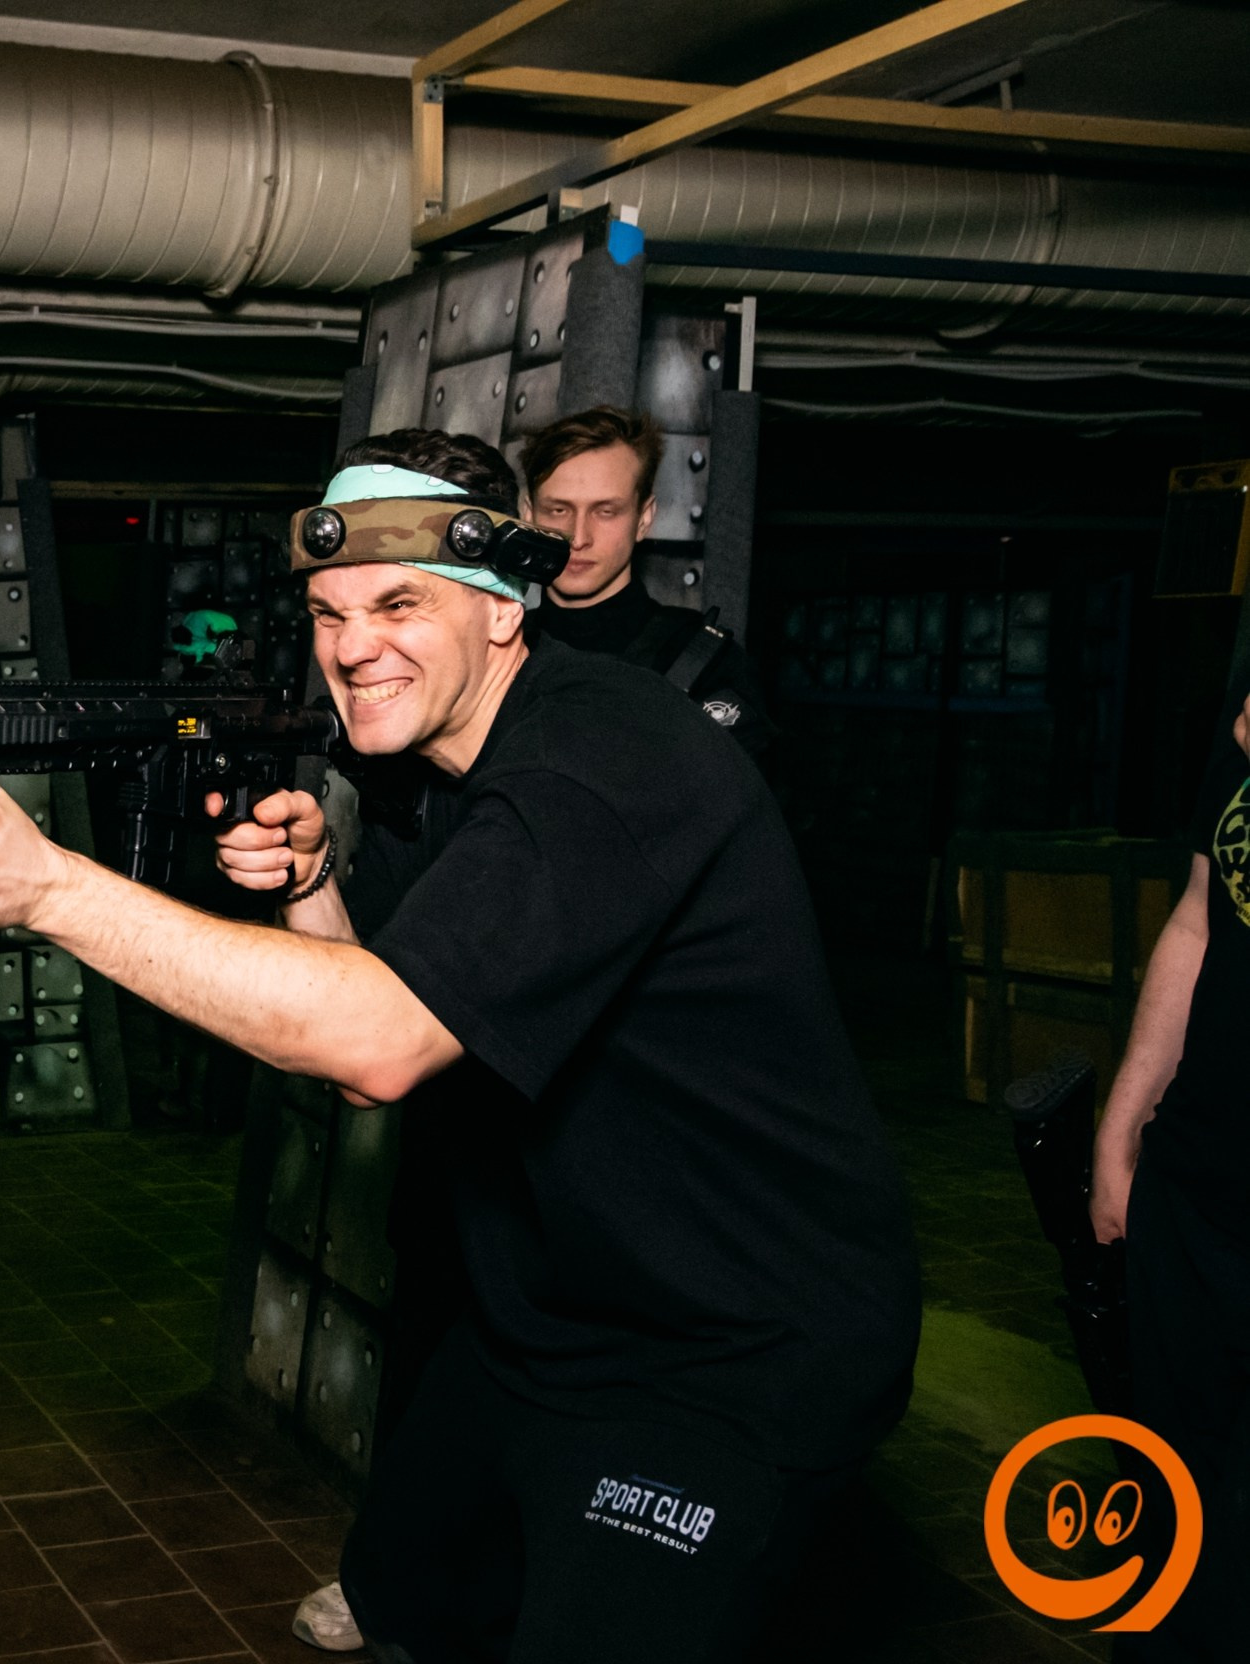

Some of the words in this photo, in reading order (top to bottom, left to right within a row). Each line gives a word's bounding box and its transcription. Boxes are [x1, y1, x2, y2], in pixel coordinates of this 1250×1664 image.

[584, 1511, 601, 1521] GET
[602, 1515, 621, 1528] THE
[622, 1521, 652, 1538] BEST
[653, 1531, 699, 1556] RESULT
[590, 1476, 656, 1518] SPORT
[652, 1495, 716, 1543] CLUB
